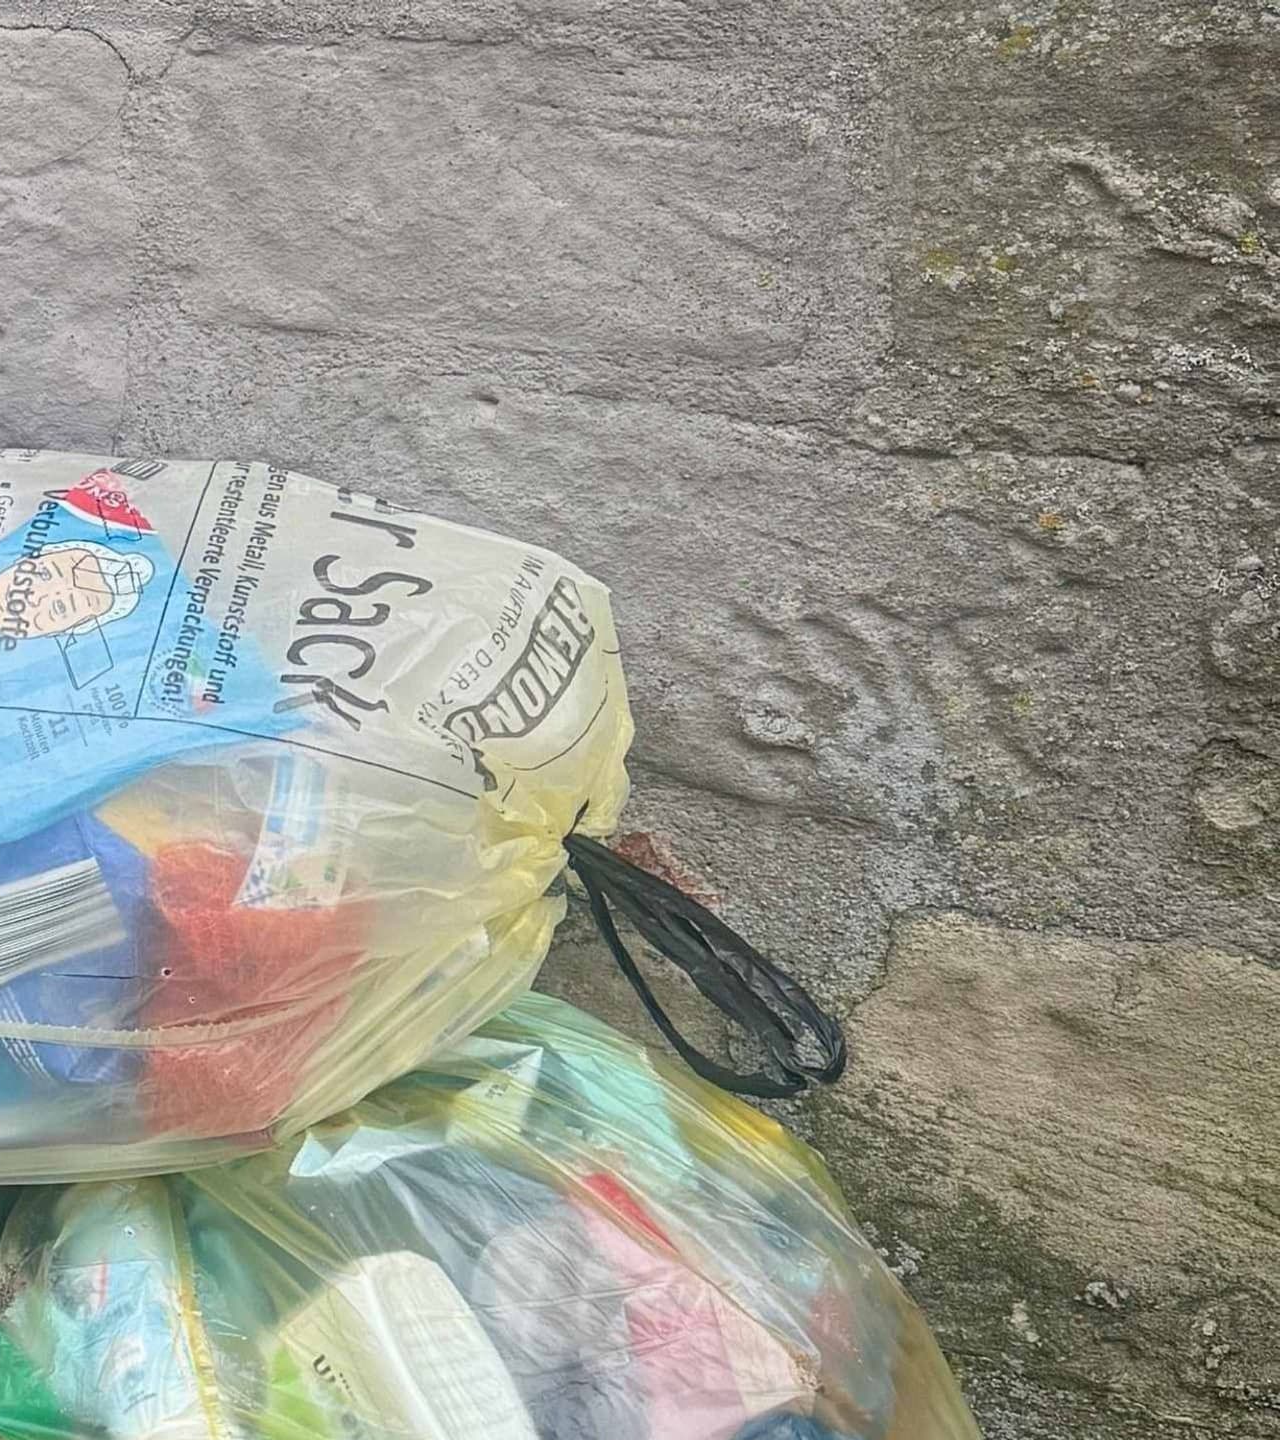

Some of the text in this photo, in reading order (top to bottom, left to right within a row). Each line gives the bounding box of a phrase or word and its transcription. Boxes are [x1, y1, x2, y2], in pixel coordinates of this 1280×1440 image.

[203, 476, 246, 567] restentleerte
[258, 493, 281, 519] aus
[240, 518, 277, 574] Metall,
[160, 563, 221, 705] Verpackungen!
[217, 573, 259, 669] Kunststoff
[273, 553, 434, 732] Sack
[104, 682, 127, 712] 100
[201, 669, 229, 704] und
[448, 648, 494, 692] DER
